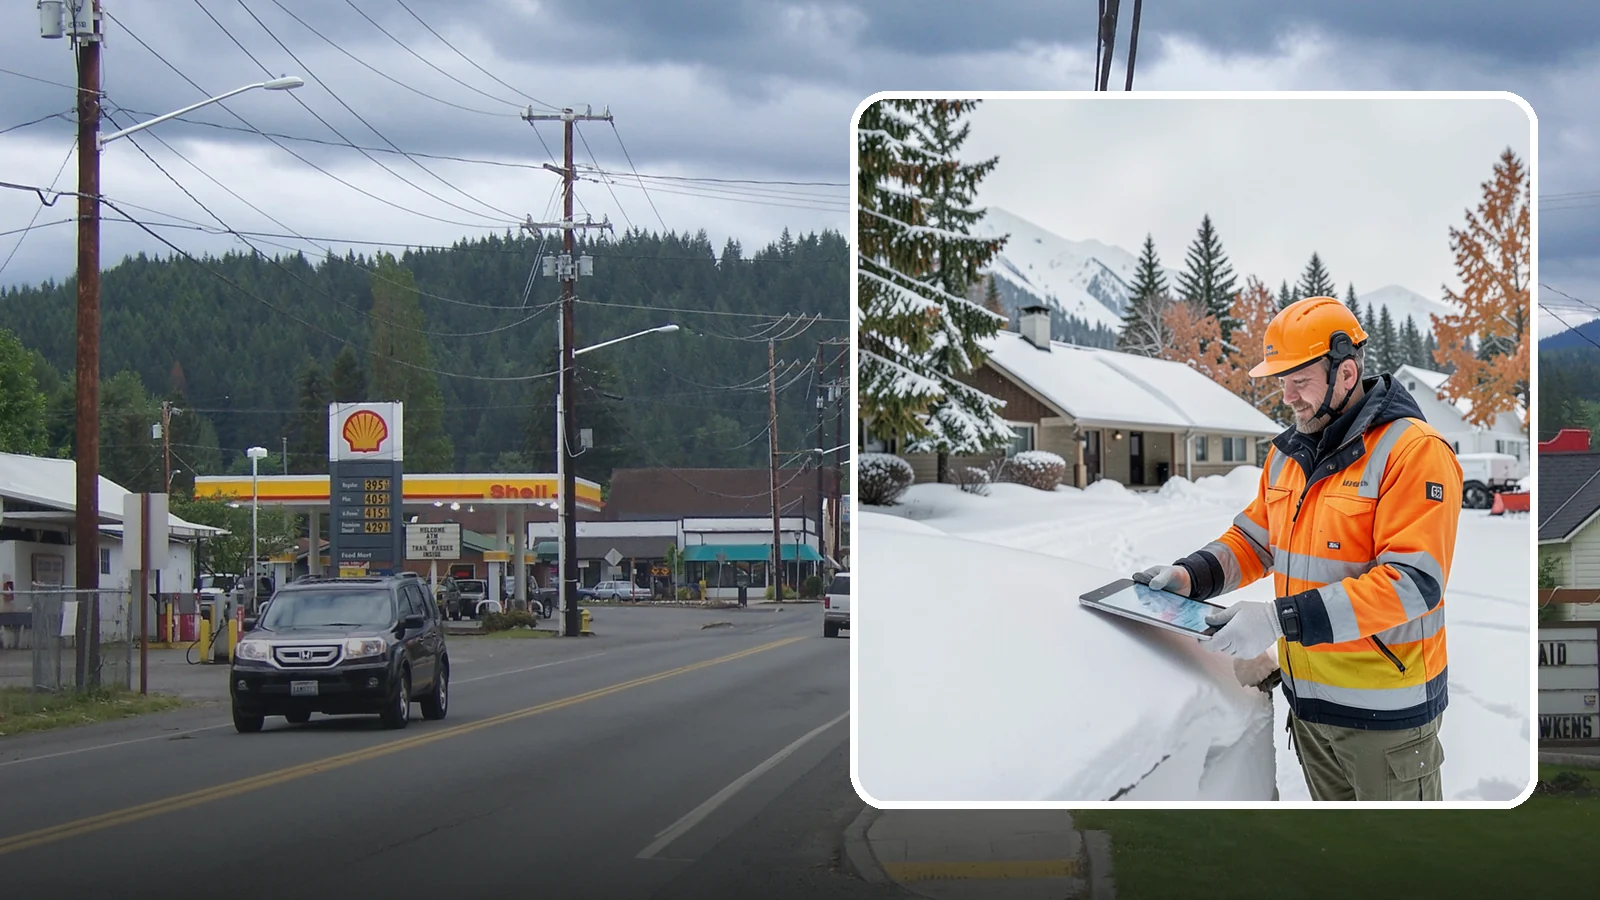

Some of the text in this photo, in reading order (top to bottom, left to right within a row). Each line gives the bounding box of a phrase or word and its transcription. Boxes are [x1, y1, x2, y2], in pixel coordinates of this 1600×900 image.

[365, 480, 384, 490] 395
[490, 484, 547, 499] Shell
[365, 494, 384, 504] 405
[365, 508, 384, 518] 415
[365, 522, 384, 533] 429
